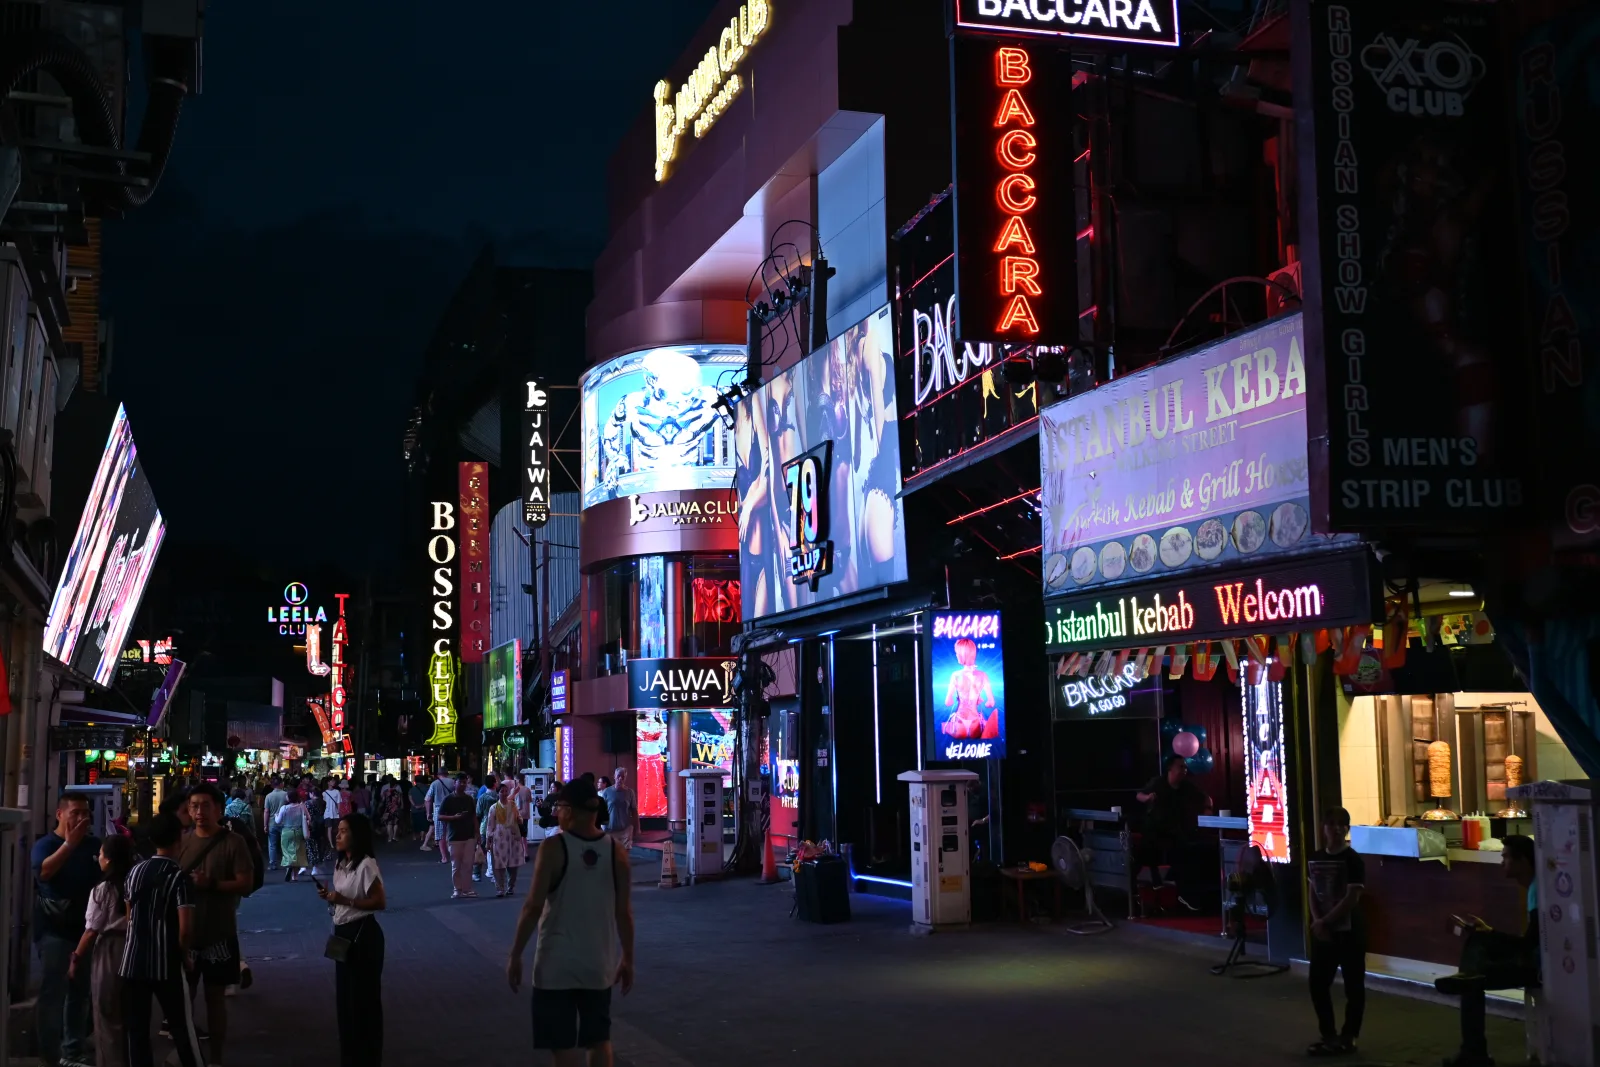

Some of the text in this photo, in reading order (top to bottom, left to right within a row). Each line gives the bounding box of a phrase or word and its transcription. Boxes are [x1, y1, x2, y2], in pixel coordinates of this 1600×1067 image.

[1380, 36, 1473, 89] XO
[1386, 86, 1465, 117] CLUB
[994, 47, 1042, 333] BACCARA
[1519, 41, 1583, 394] RUSSIAN
[1327, 4, 1371, 467] RUSSIAN SHOW GIRLS
[1181, 420, 1238, 455] STREET
[1382, 437, 1478, 467] MEN'S
[526, 412, 546, 502] JALWA
[1198, 458, 1243, 512] Grill
[1340, 477, 1524, 509] STRIP CLUB
[526, 512, 546, 522] F2-3
[648, 500, 701, 518] JALWA
[672, 516, 723, 525] PATTAYA
[791, 548, 821, 577] CLUB
[267, 606, 328, 623] LEELA
[428, 501, 456, 725] BOSS CLUB
[932, 614, 999, 639] BACCARA
[1057, 598, 1126, 644] istanbul
[1132, 590, 1194, 635] kebab
[639, 669, 722, 692] JALWA
[660, 692, 699, 702] CLUB
[1089, 695, 1126, 715] A GO GO
[945, 741, 993, 760] WELCOME
